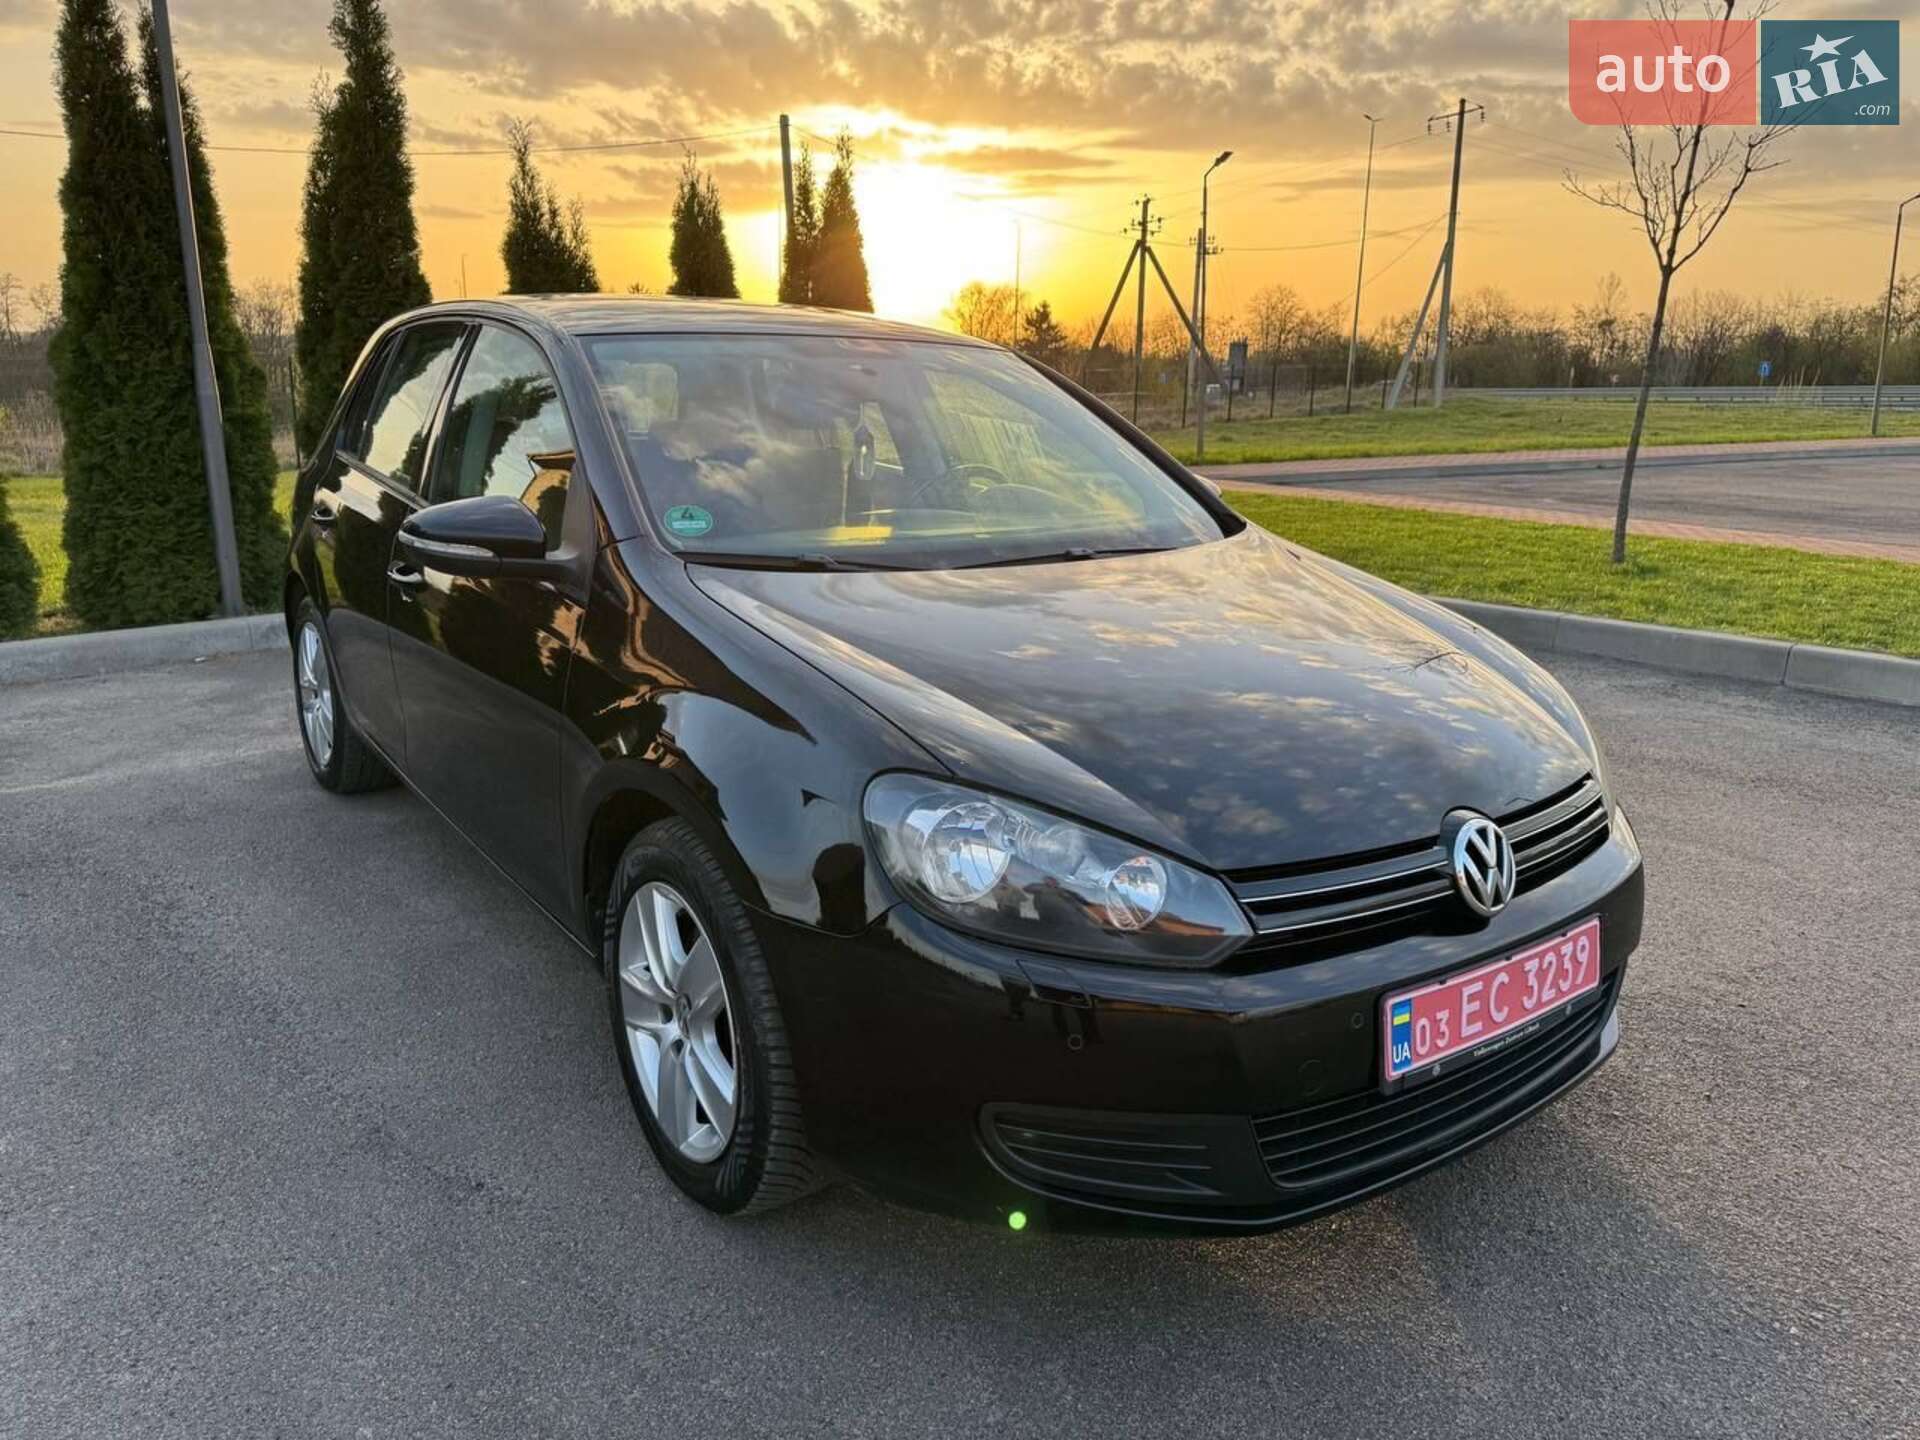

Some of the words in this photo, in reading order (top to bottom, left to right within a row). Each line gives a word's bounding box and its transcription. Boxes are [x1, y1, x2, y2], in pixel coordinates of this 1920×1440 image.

[1415, 1009, 1450, 1055] 03
[1461, 972, 1510, 1038] EC
[1522, 935, 1590, 1010] 3239
[1393, 1043, 1411, 1063] UA
